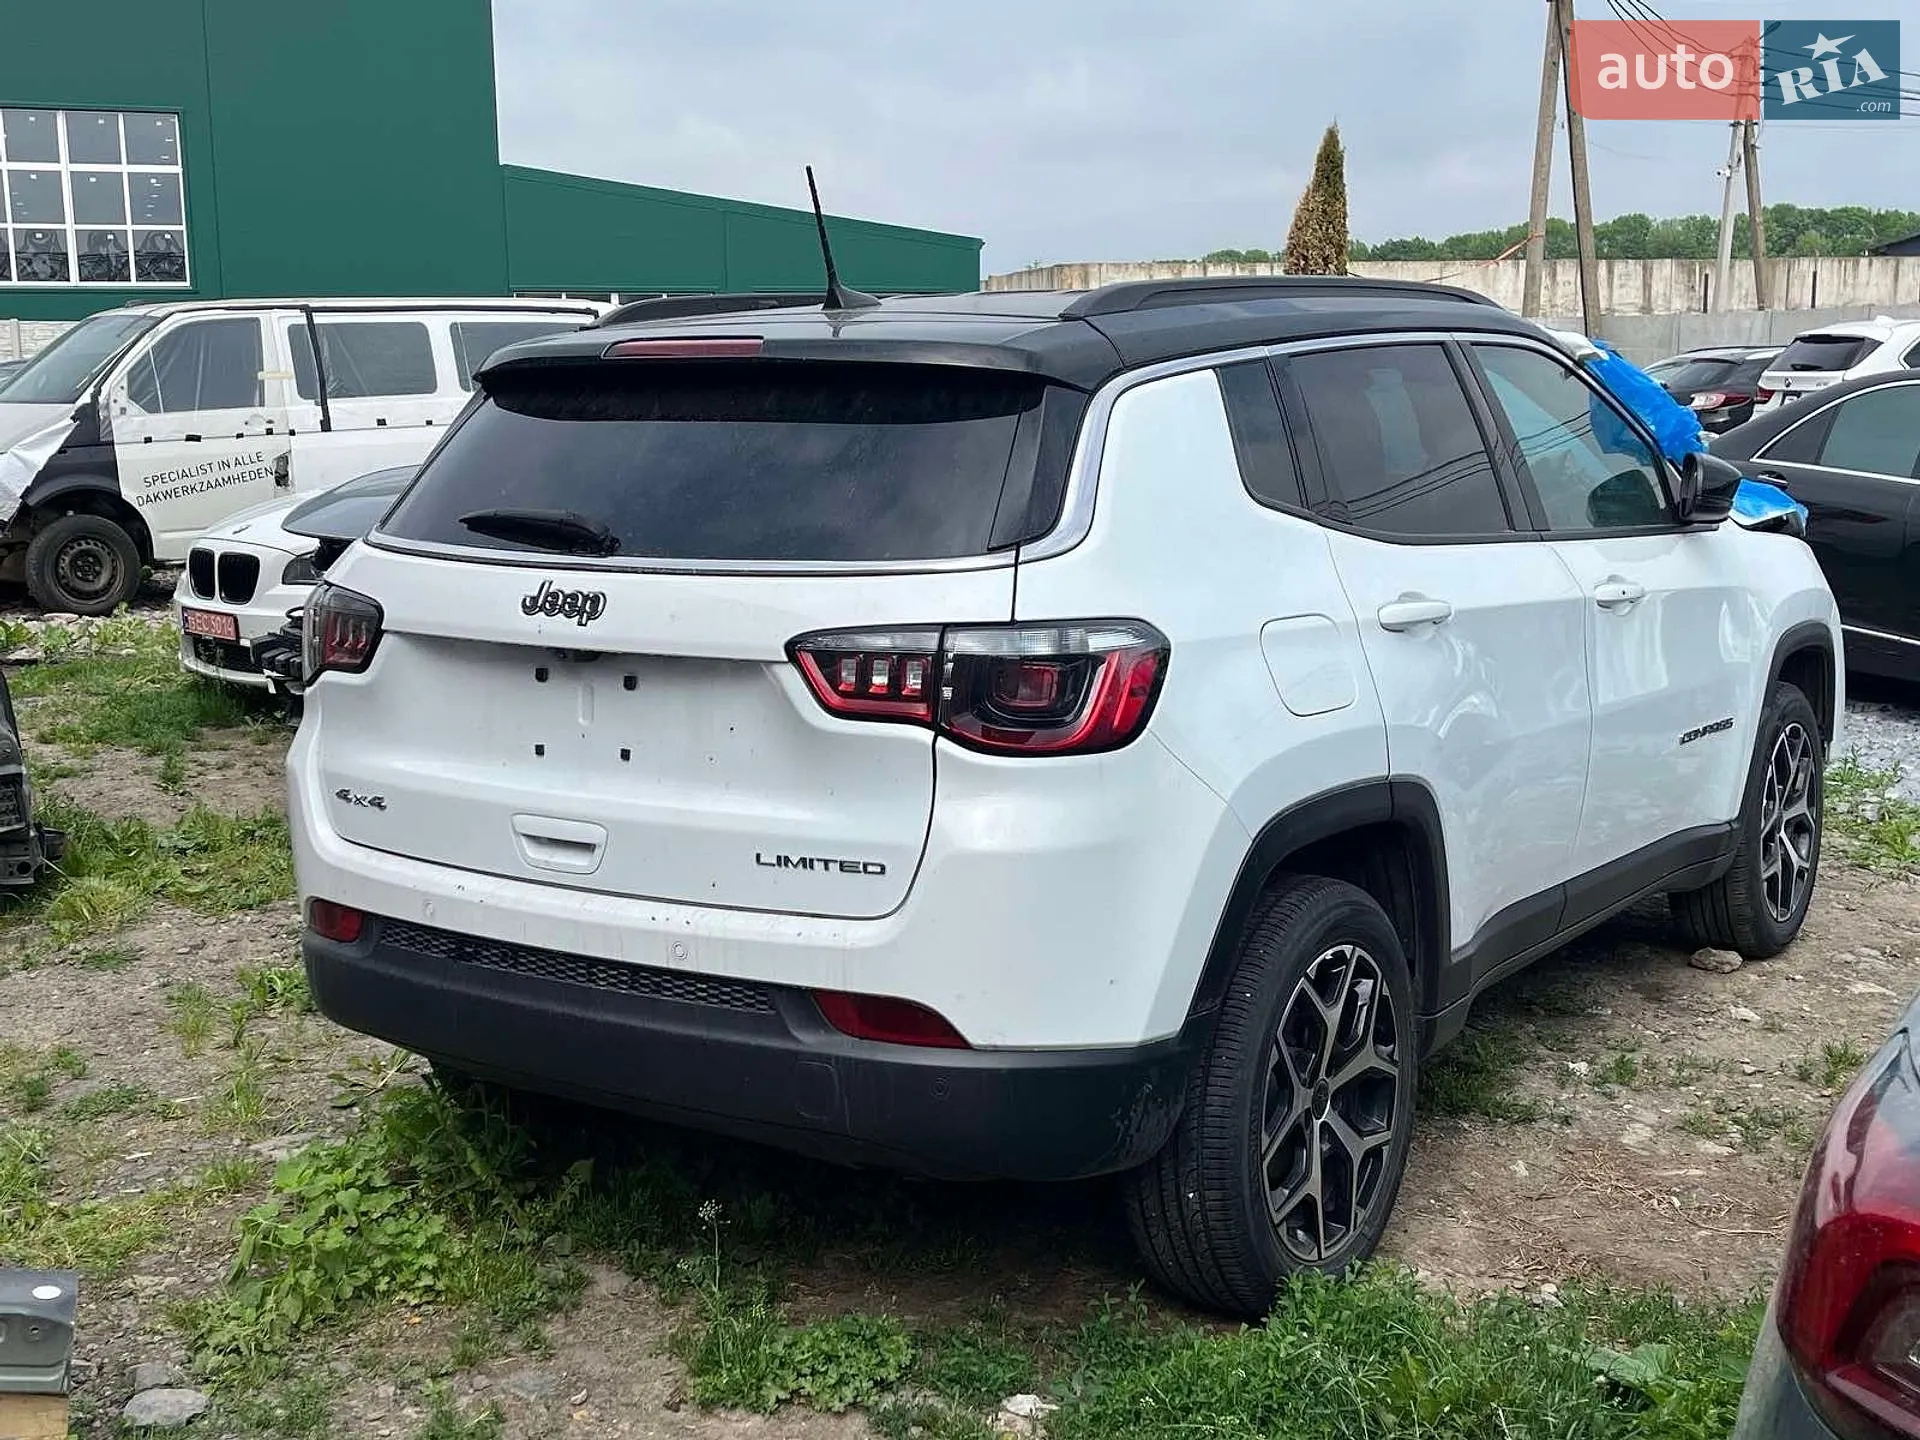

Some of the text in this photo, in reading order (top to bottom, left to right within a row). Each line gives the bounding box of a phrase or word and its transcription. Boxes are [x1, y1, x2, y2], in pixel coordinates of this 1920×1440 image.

[135, 466, 274, 507] DAKWERKZAAMHEDEN
[143, 451, 264, 488] SPECIALIST IN ALLE
[521, 580, 607, 626] Jeep
[755, 852, 886, 875] LIMITED
